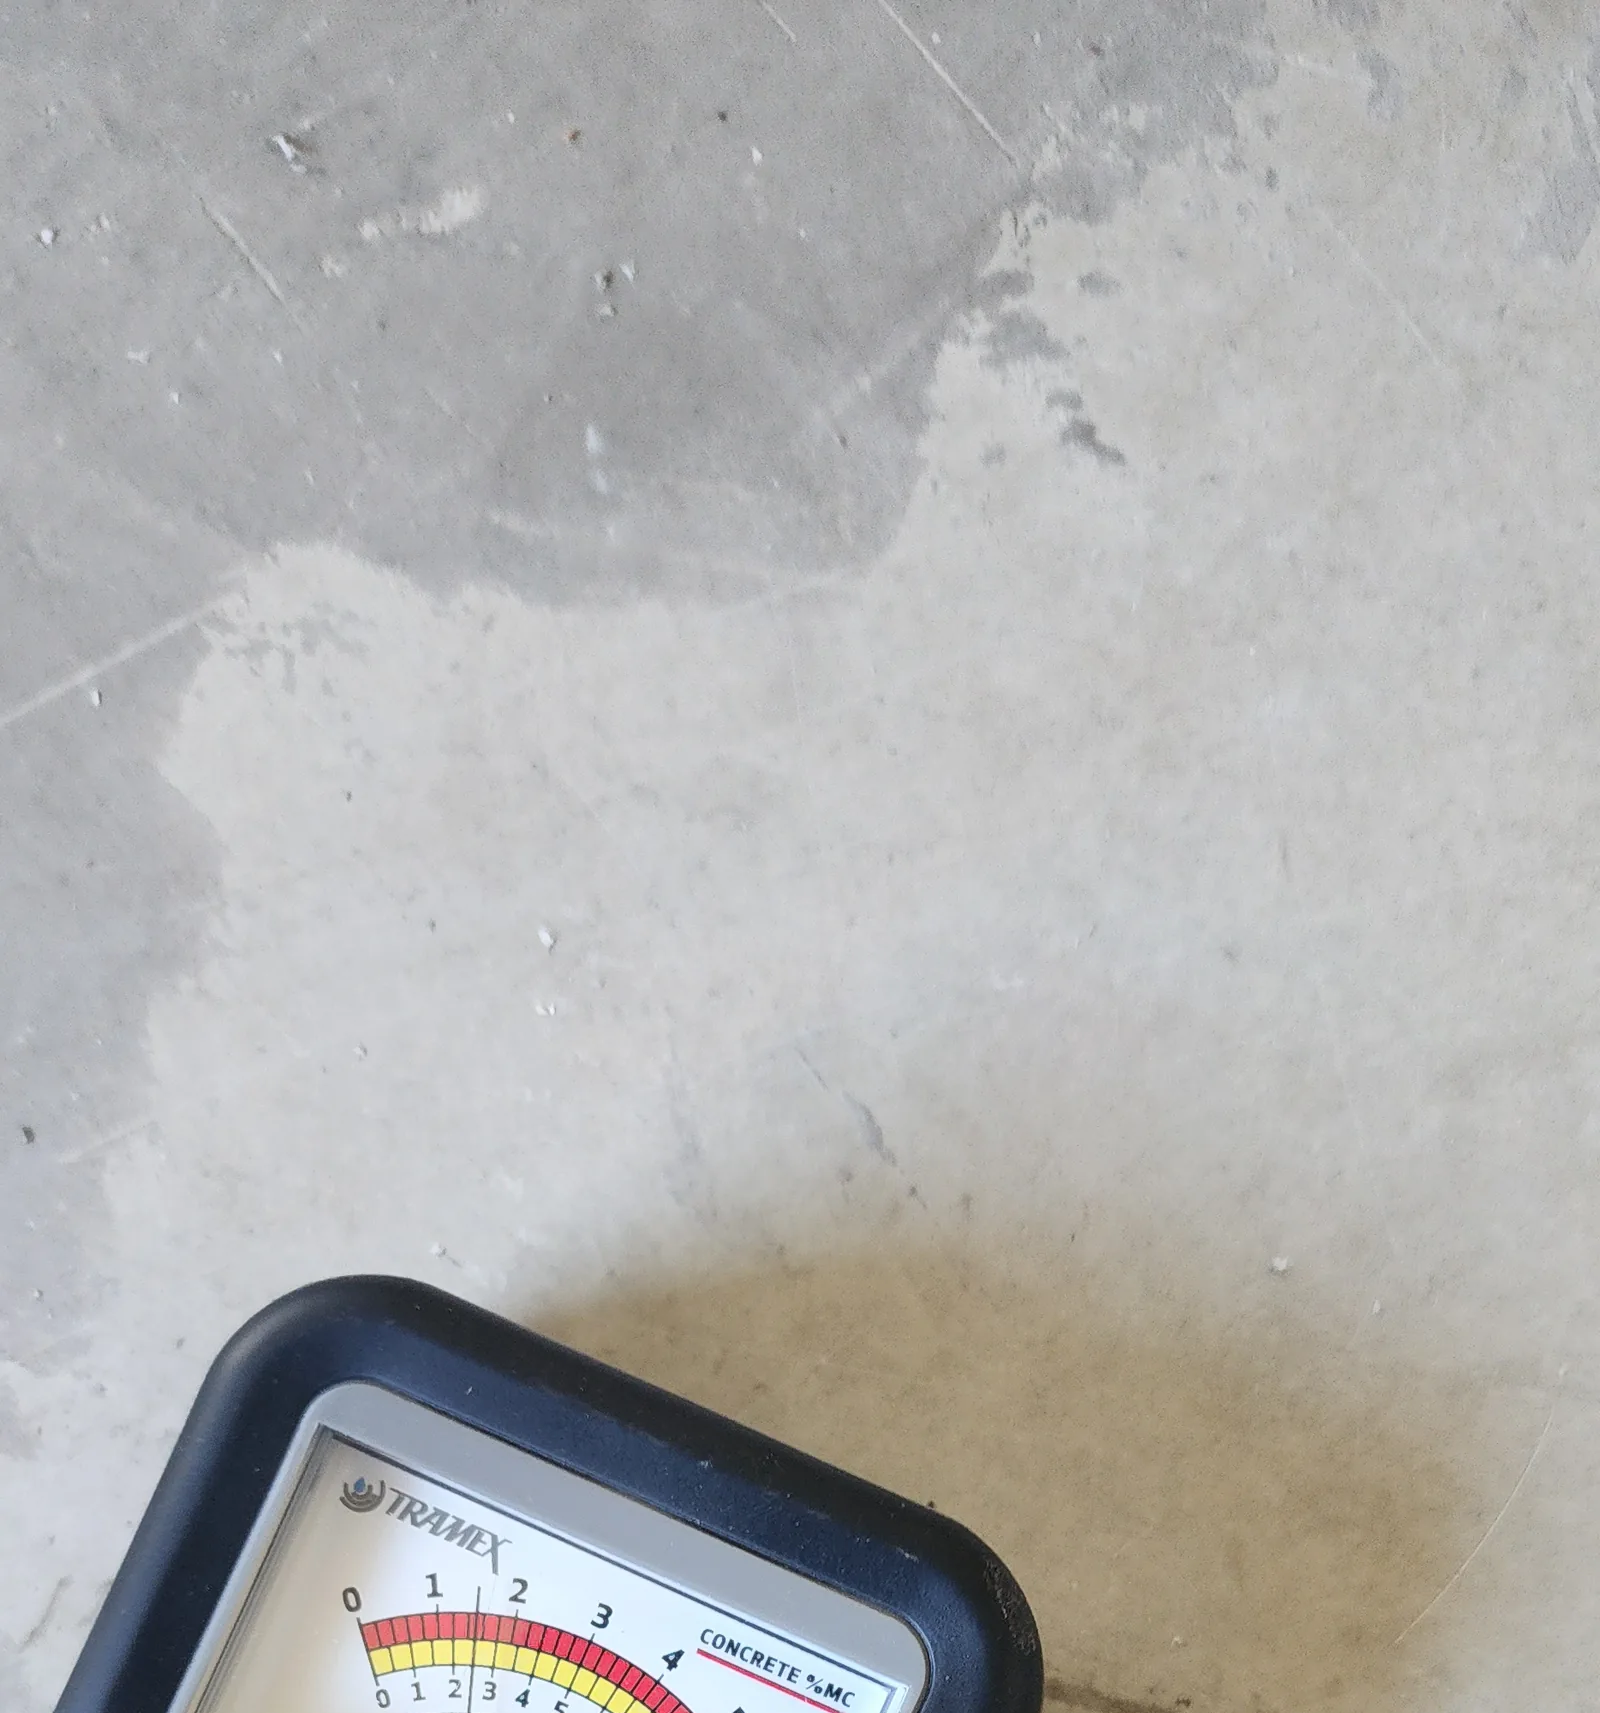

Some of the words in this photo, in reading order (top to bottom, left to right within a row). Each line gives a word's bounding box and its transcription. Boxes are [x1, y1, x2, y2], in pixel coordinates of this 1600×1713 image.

[385, 1487, 513, 1576] TRAMEX
[342, 1586, 363, 1613] 0
[424, 1573, 443, 1598] 1
[508, 1578, 529, 1604] 2
[590, 1602, 614, 1630] 3
[661, 1649, 686, 1672] 4
[375, 1688, 391, 1709] 0
[411, 1681, 426, 1702] 1
[448, 1679, 462, 1699] 2
[482, 1681, 497, 1701] 3
[515, 1688, 530, 1708] 4
[699, 1628, 802, 1684] CONCRETE
[806, 1673, 856, 1708] %MC
